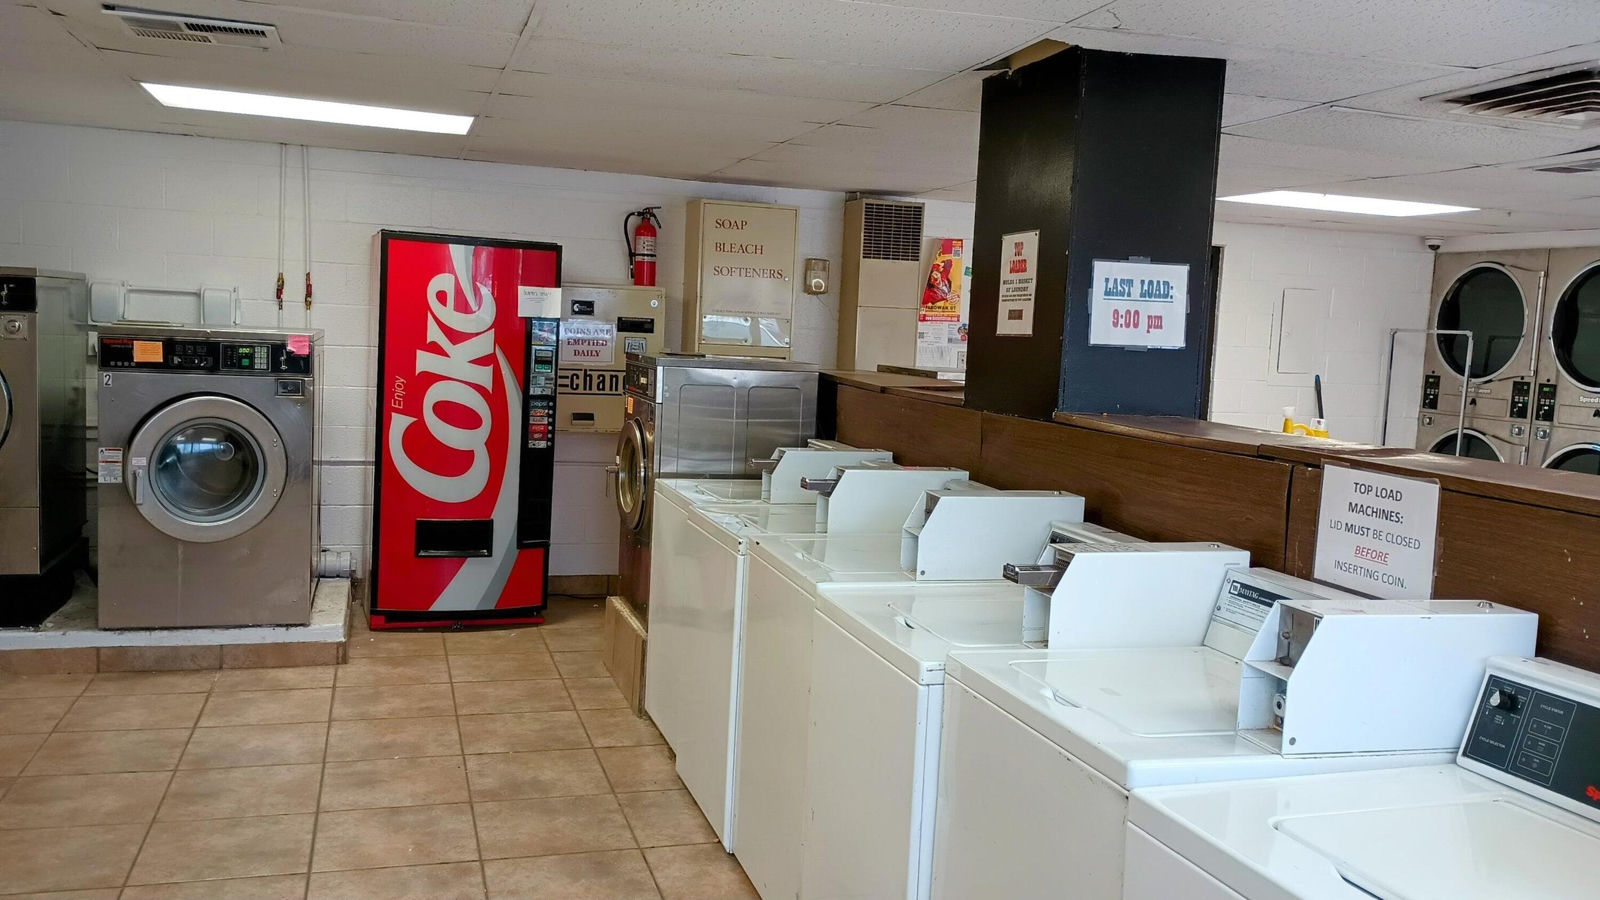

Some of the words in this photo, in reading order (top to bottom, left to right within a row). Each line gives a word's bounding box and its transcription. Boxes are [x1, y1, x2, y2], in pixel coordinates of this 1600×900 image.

[715, 219, 748, 230] SOAP
[715, 242, 764, 255] BLEACH
[714, 266, 784, 280] SOFTENERS
[1104, 278, 1134, 298] LAST
[1140, 280, 1174, 300] LOAD:
[1112, 308, 1140, 328] 9:00
[1146, 315, 1163, 334] pm
[564, 327, 591, 336] COINS
[592, 328, 612, 336] ARE
[567, 338, 608, 347] EMPTIED
[574, 350, 601, 358] DAILY
[104, 374, 112, 387] 2
[389, 273, 497, 503] Coke
[570, 369, 626, 392] chan
[392, 376, 407, 409] Enjoy
[1354, 482, 1373, 496] TOP
[1375, 486, 1403, 502] LOAD
[1348, 502, 1404, 524] MACHINES:
[1330, 520, 1343, 531] LID
[1344, 522, 1371, 538] MUST
[1372, 529, 1383, 541] BE
[1386, 532, 1421, 550] CLOSED
[1354, 545, 1390, 563] BEFORE
[1334, 560, 1380, 582] INSERTING
[1382, 572, 1407, 590] COIN.
